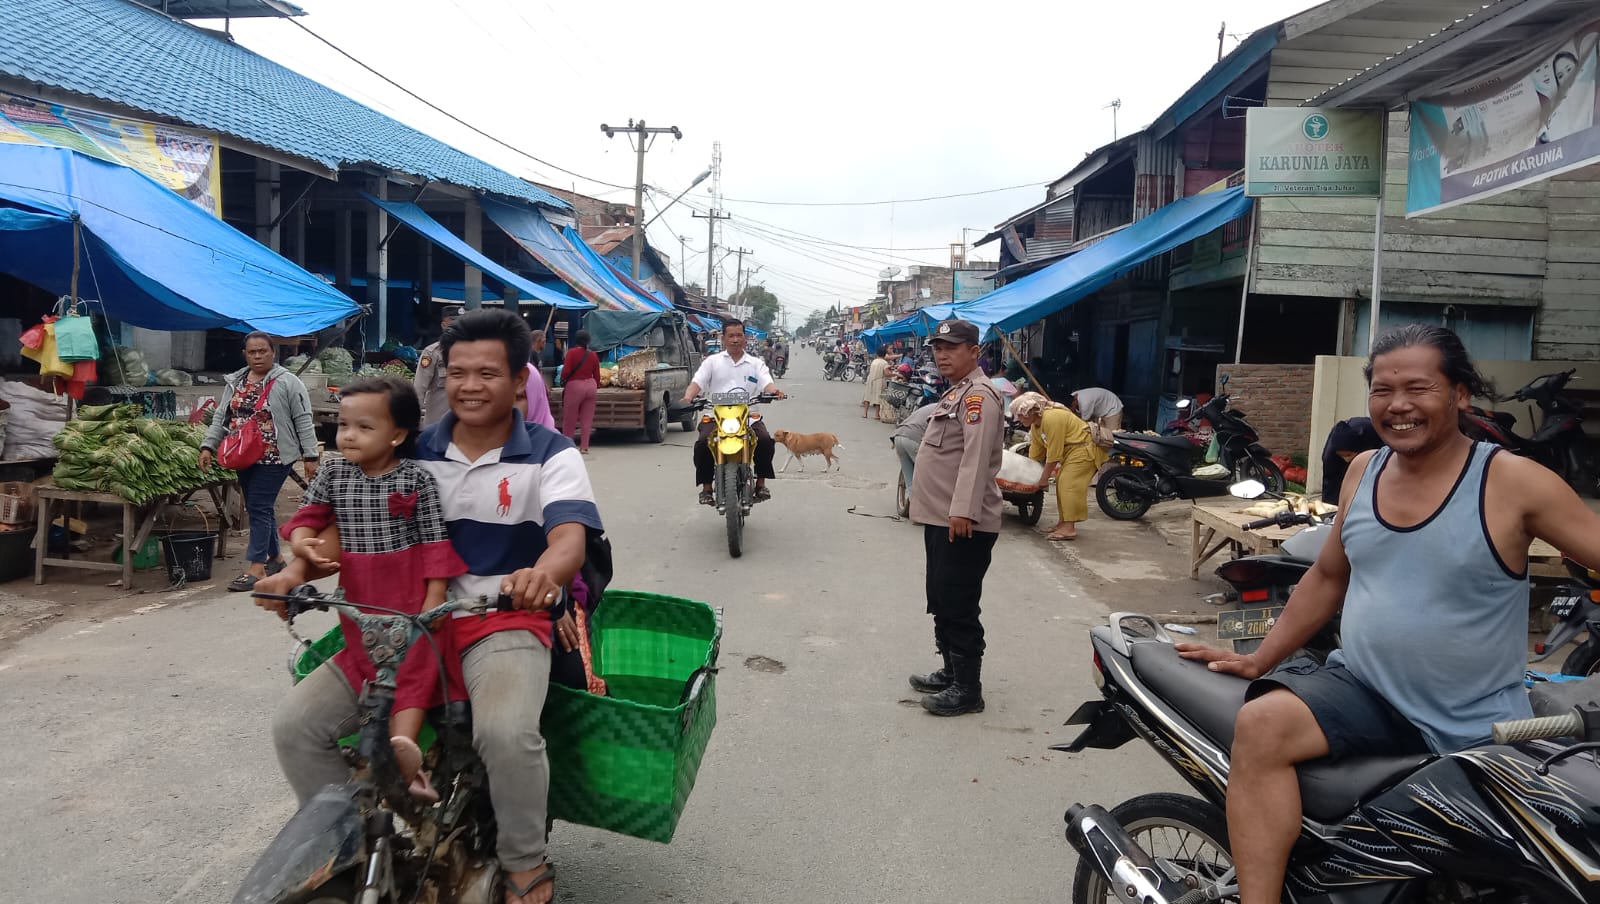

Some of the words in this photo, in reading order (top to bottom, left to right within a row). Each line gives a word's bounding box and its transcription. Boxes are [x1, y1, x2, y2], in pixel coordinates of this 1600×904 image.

[1259, 156, 1330, 171] KARUNIA
[1333, 156, 1370, 171] JAYA
[1472, 164, 1510, 188] APOTIK
[1511, 146, 1564, 175] KARUNIA
[1284, 184, 1314, 192] Veteran
